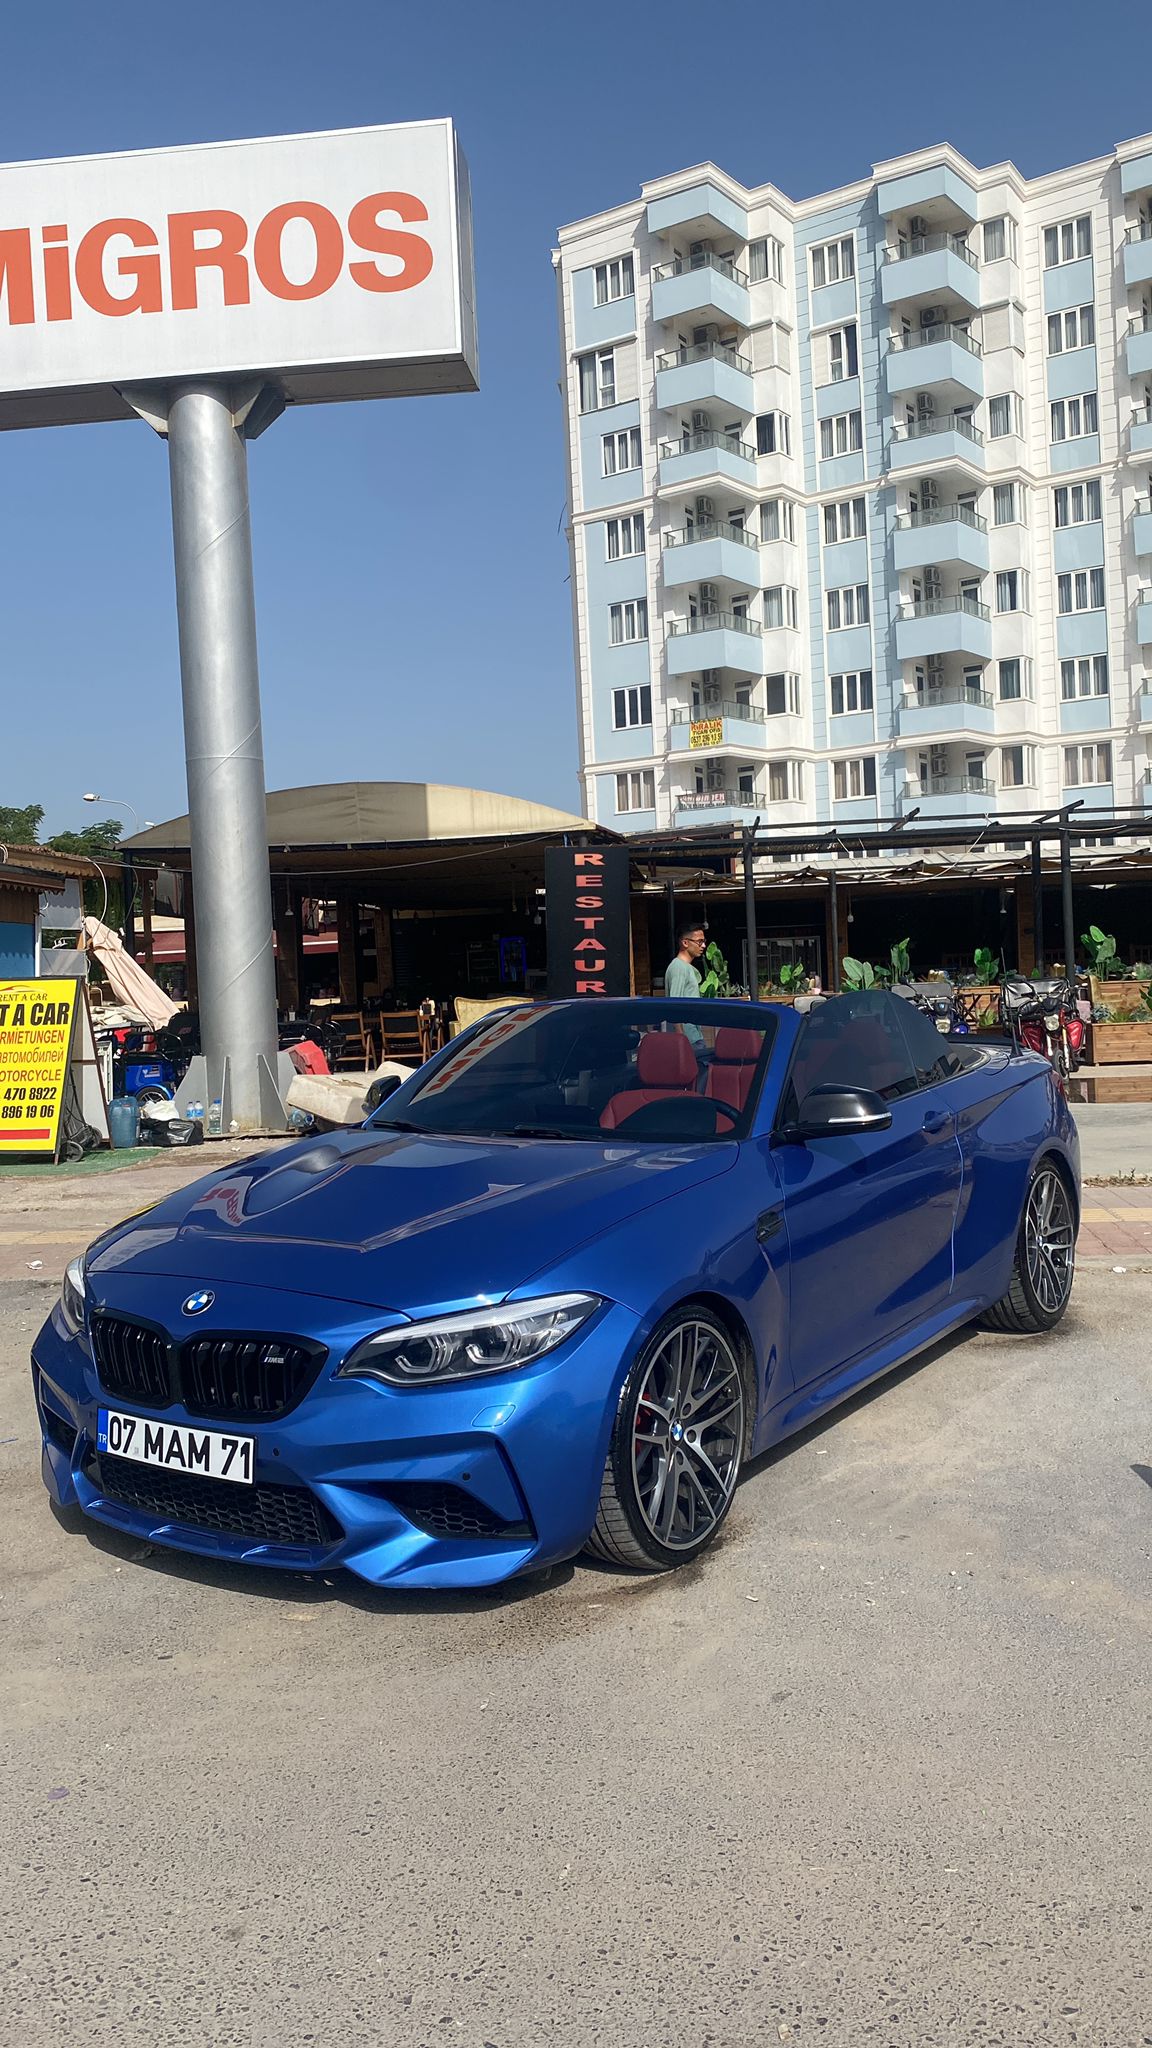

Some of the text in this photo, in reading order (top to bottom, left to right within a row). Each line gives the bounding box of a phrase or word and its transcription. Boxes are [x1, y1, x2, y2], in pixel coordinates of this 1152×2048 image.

[573, 853, 607, 993] RESTAUR
[21, 993, 28, 1002] A
[30, 993, 48, 1001] CAR
[12, 1003, 25, 1026] A
[30, 1002, 70, 1026] CAR
[4, 1087, 57, 1101] 470 8922
[1, 1105, 54, 1119] 896 19 06
[98, 1433, 108, 1444] TR
[109, 1415, 251, 1480] 07 MAM 71
